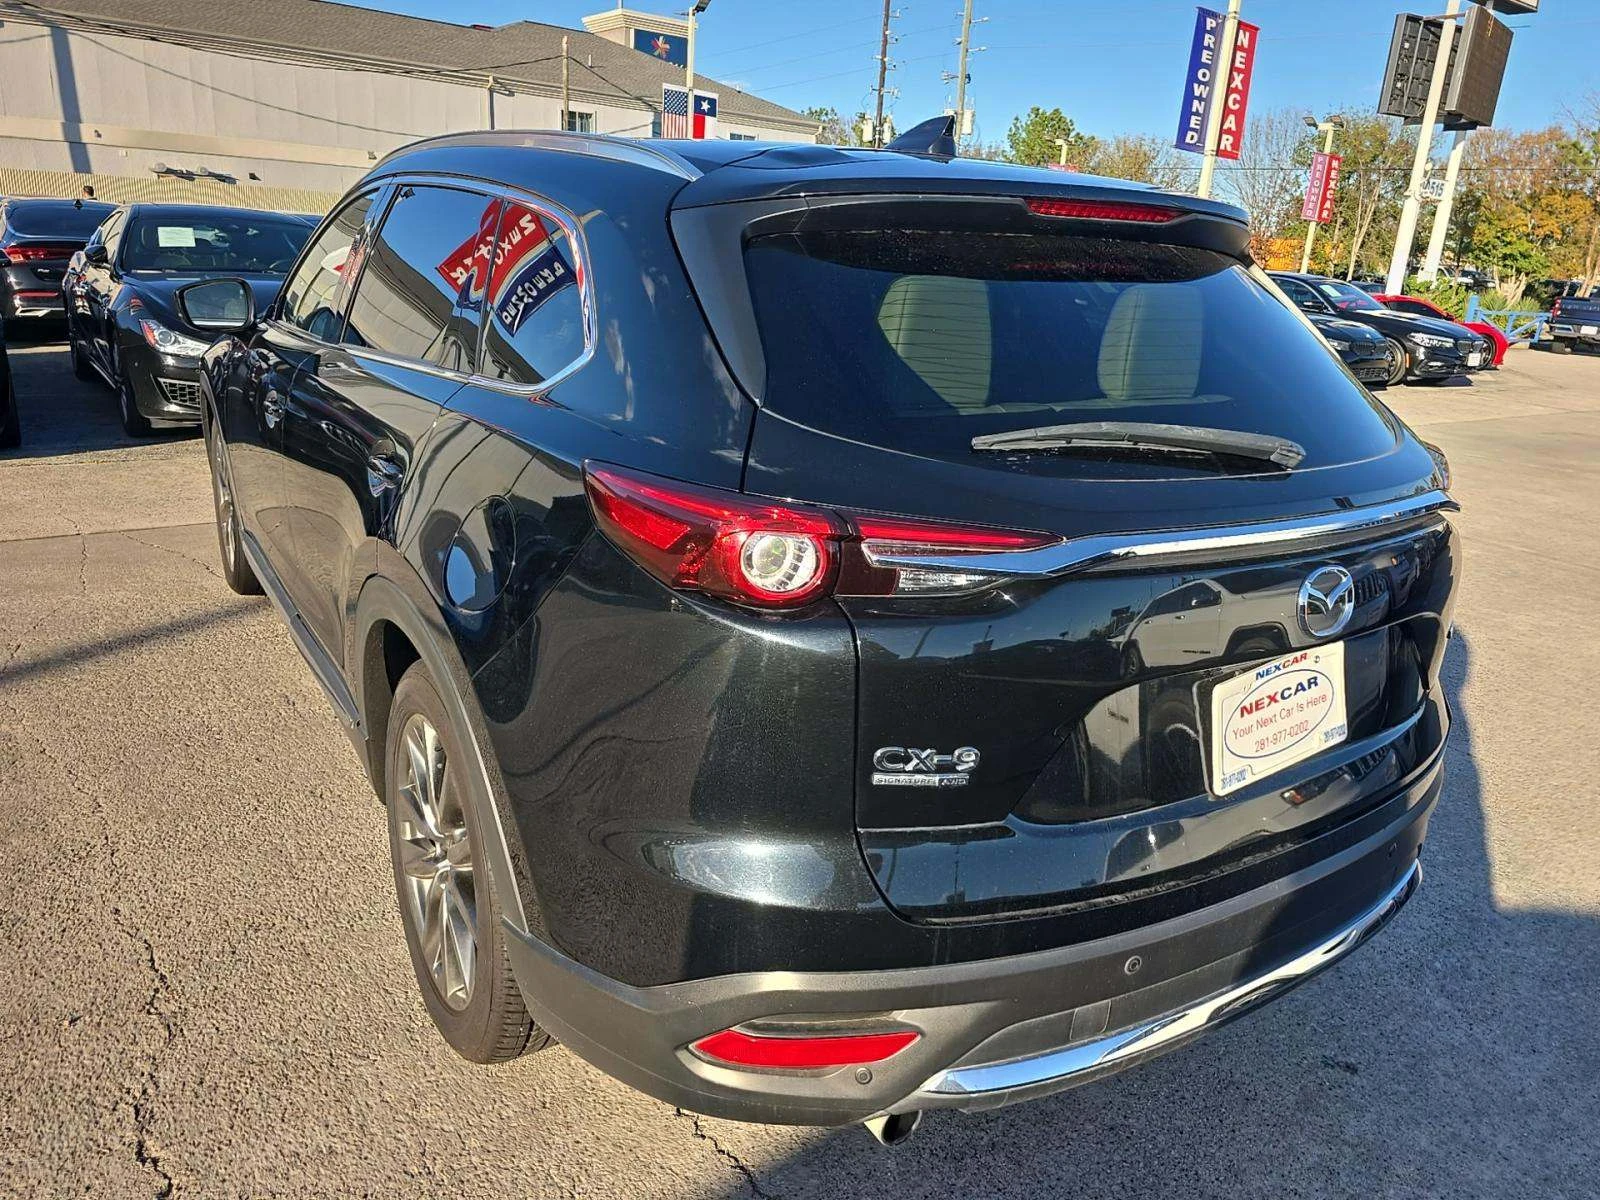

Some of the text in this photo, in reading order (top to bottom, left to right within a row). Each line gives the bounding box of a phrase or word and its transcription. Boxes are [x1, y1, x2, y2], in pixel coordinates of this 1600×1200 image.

[1220, 29, 1249, 151] NEXCAR
[1322, 159, 1339, 218] NEXCAR
[1255, 652, 1308, 680] NEXCAR
[1240, 676, 1319, 718] NEXCAR
[1232, 694, 1327, 740] Your Next Car Is Here
[1255, 720, 1310, 753] 281-977-0202
[873, 746, 981, 772] CX-9
[875, 776, 937, 786] SIGNATURE
